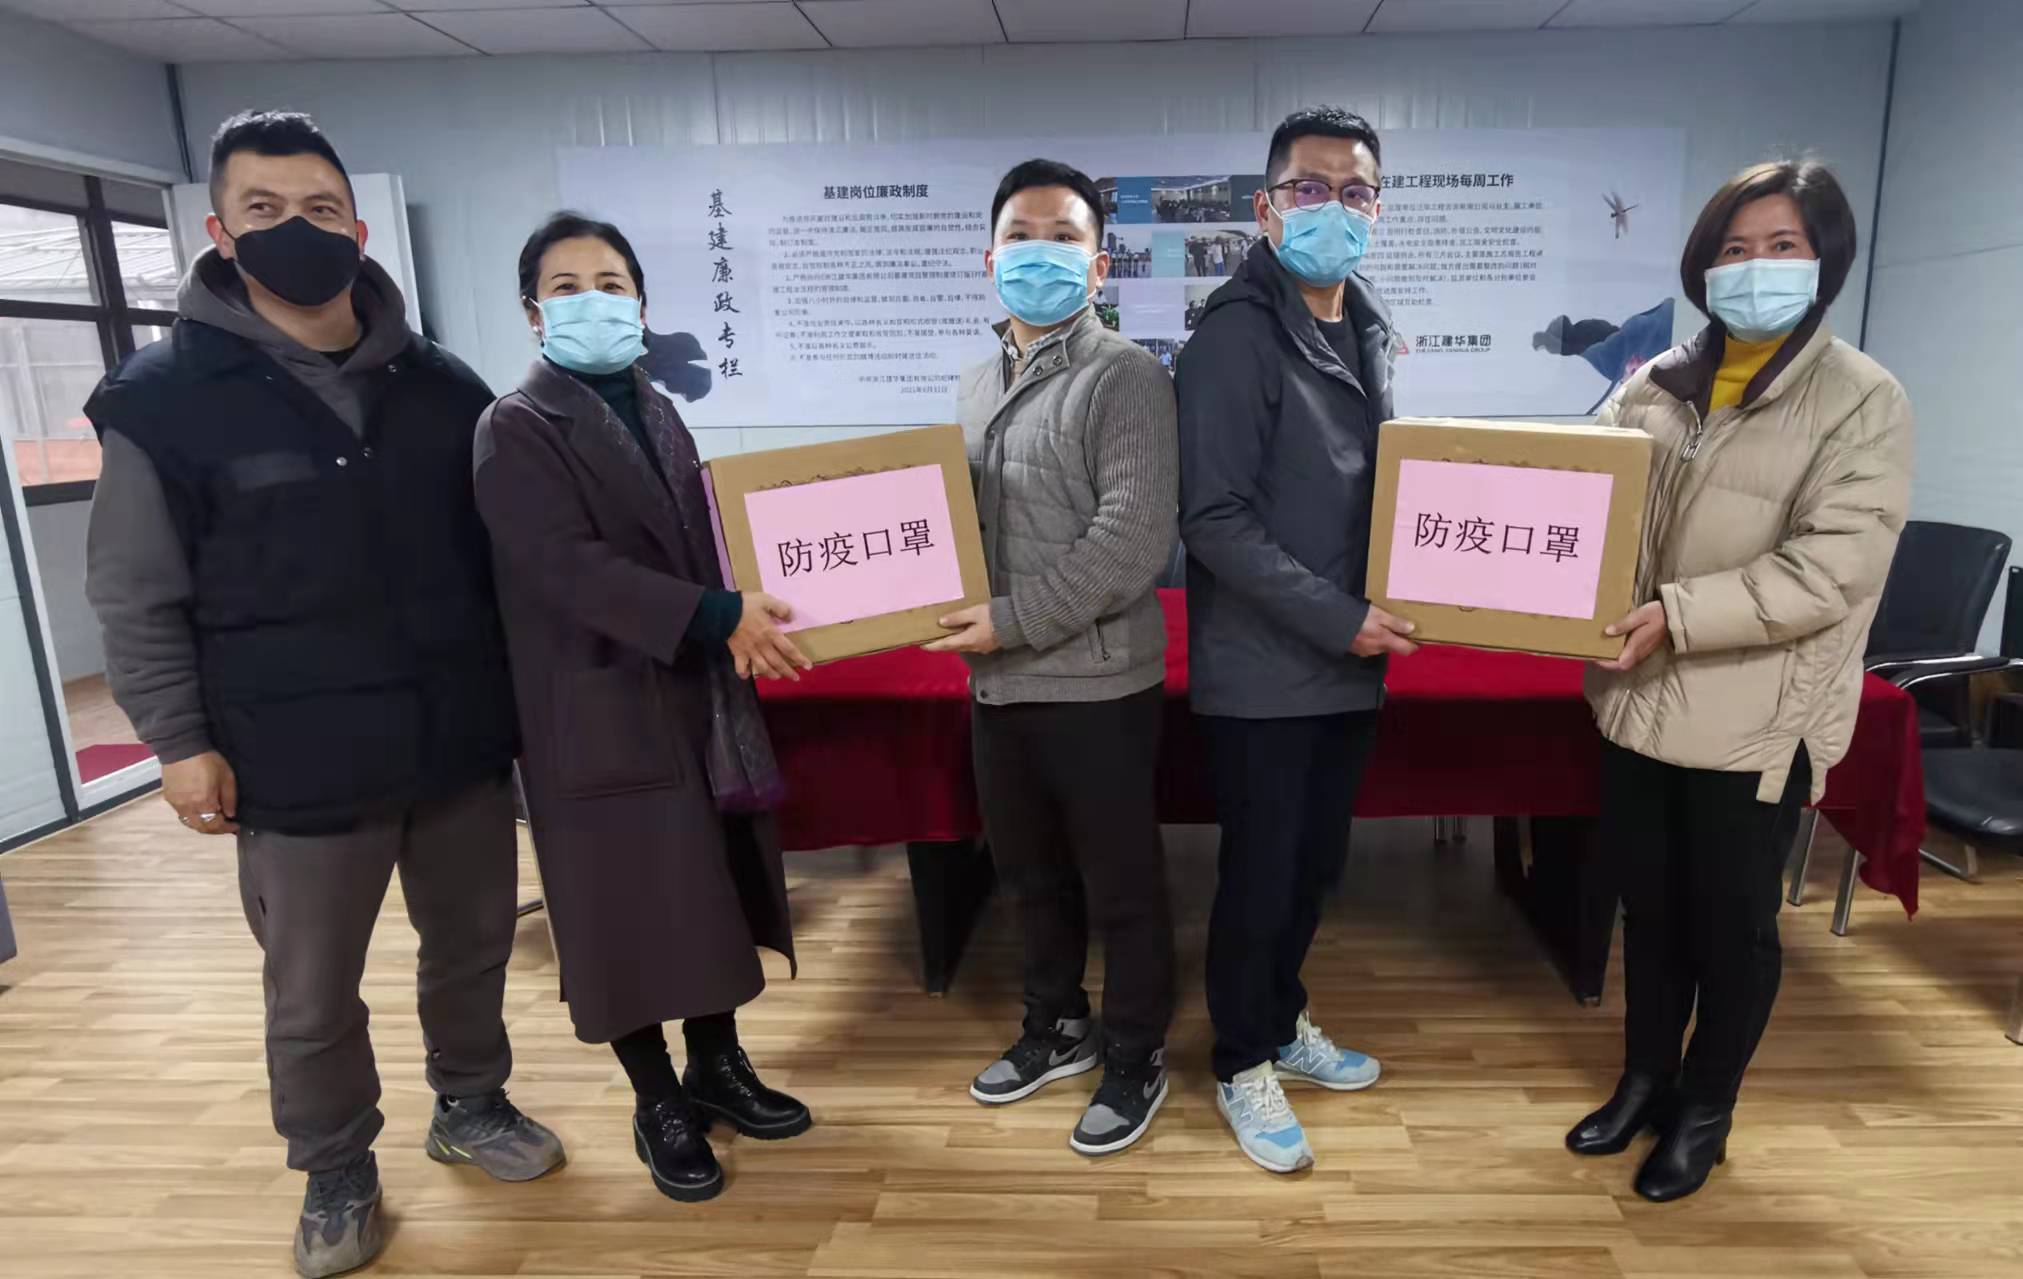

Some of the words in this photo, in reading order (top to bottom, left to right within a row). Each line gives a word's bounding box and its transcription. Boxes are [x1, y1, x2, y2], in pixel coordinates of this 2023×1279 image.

[823, 184, 929, 200] 基建岗位廉政制度
[1381, 173, 1514, 188] 在建工程现场每周工作
[708, 188, 743, 379] 基建廉政专栏
[1416, 334, 1491, 347] 浙江建华集团
[777, 518, 935, 578] 防疫口罩
[1414, 512, 1580, 563] 防疫口罩
